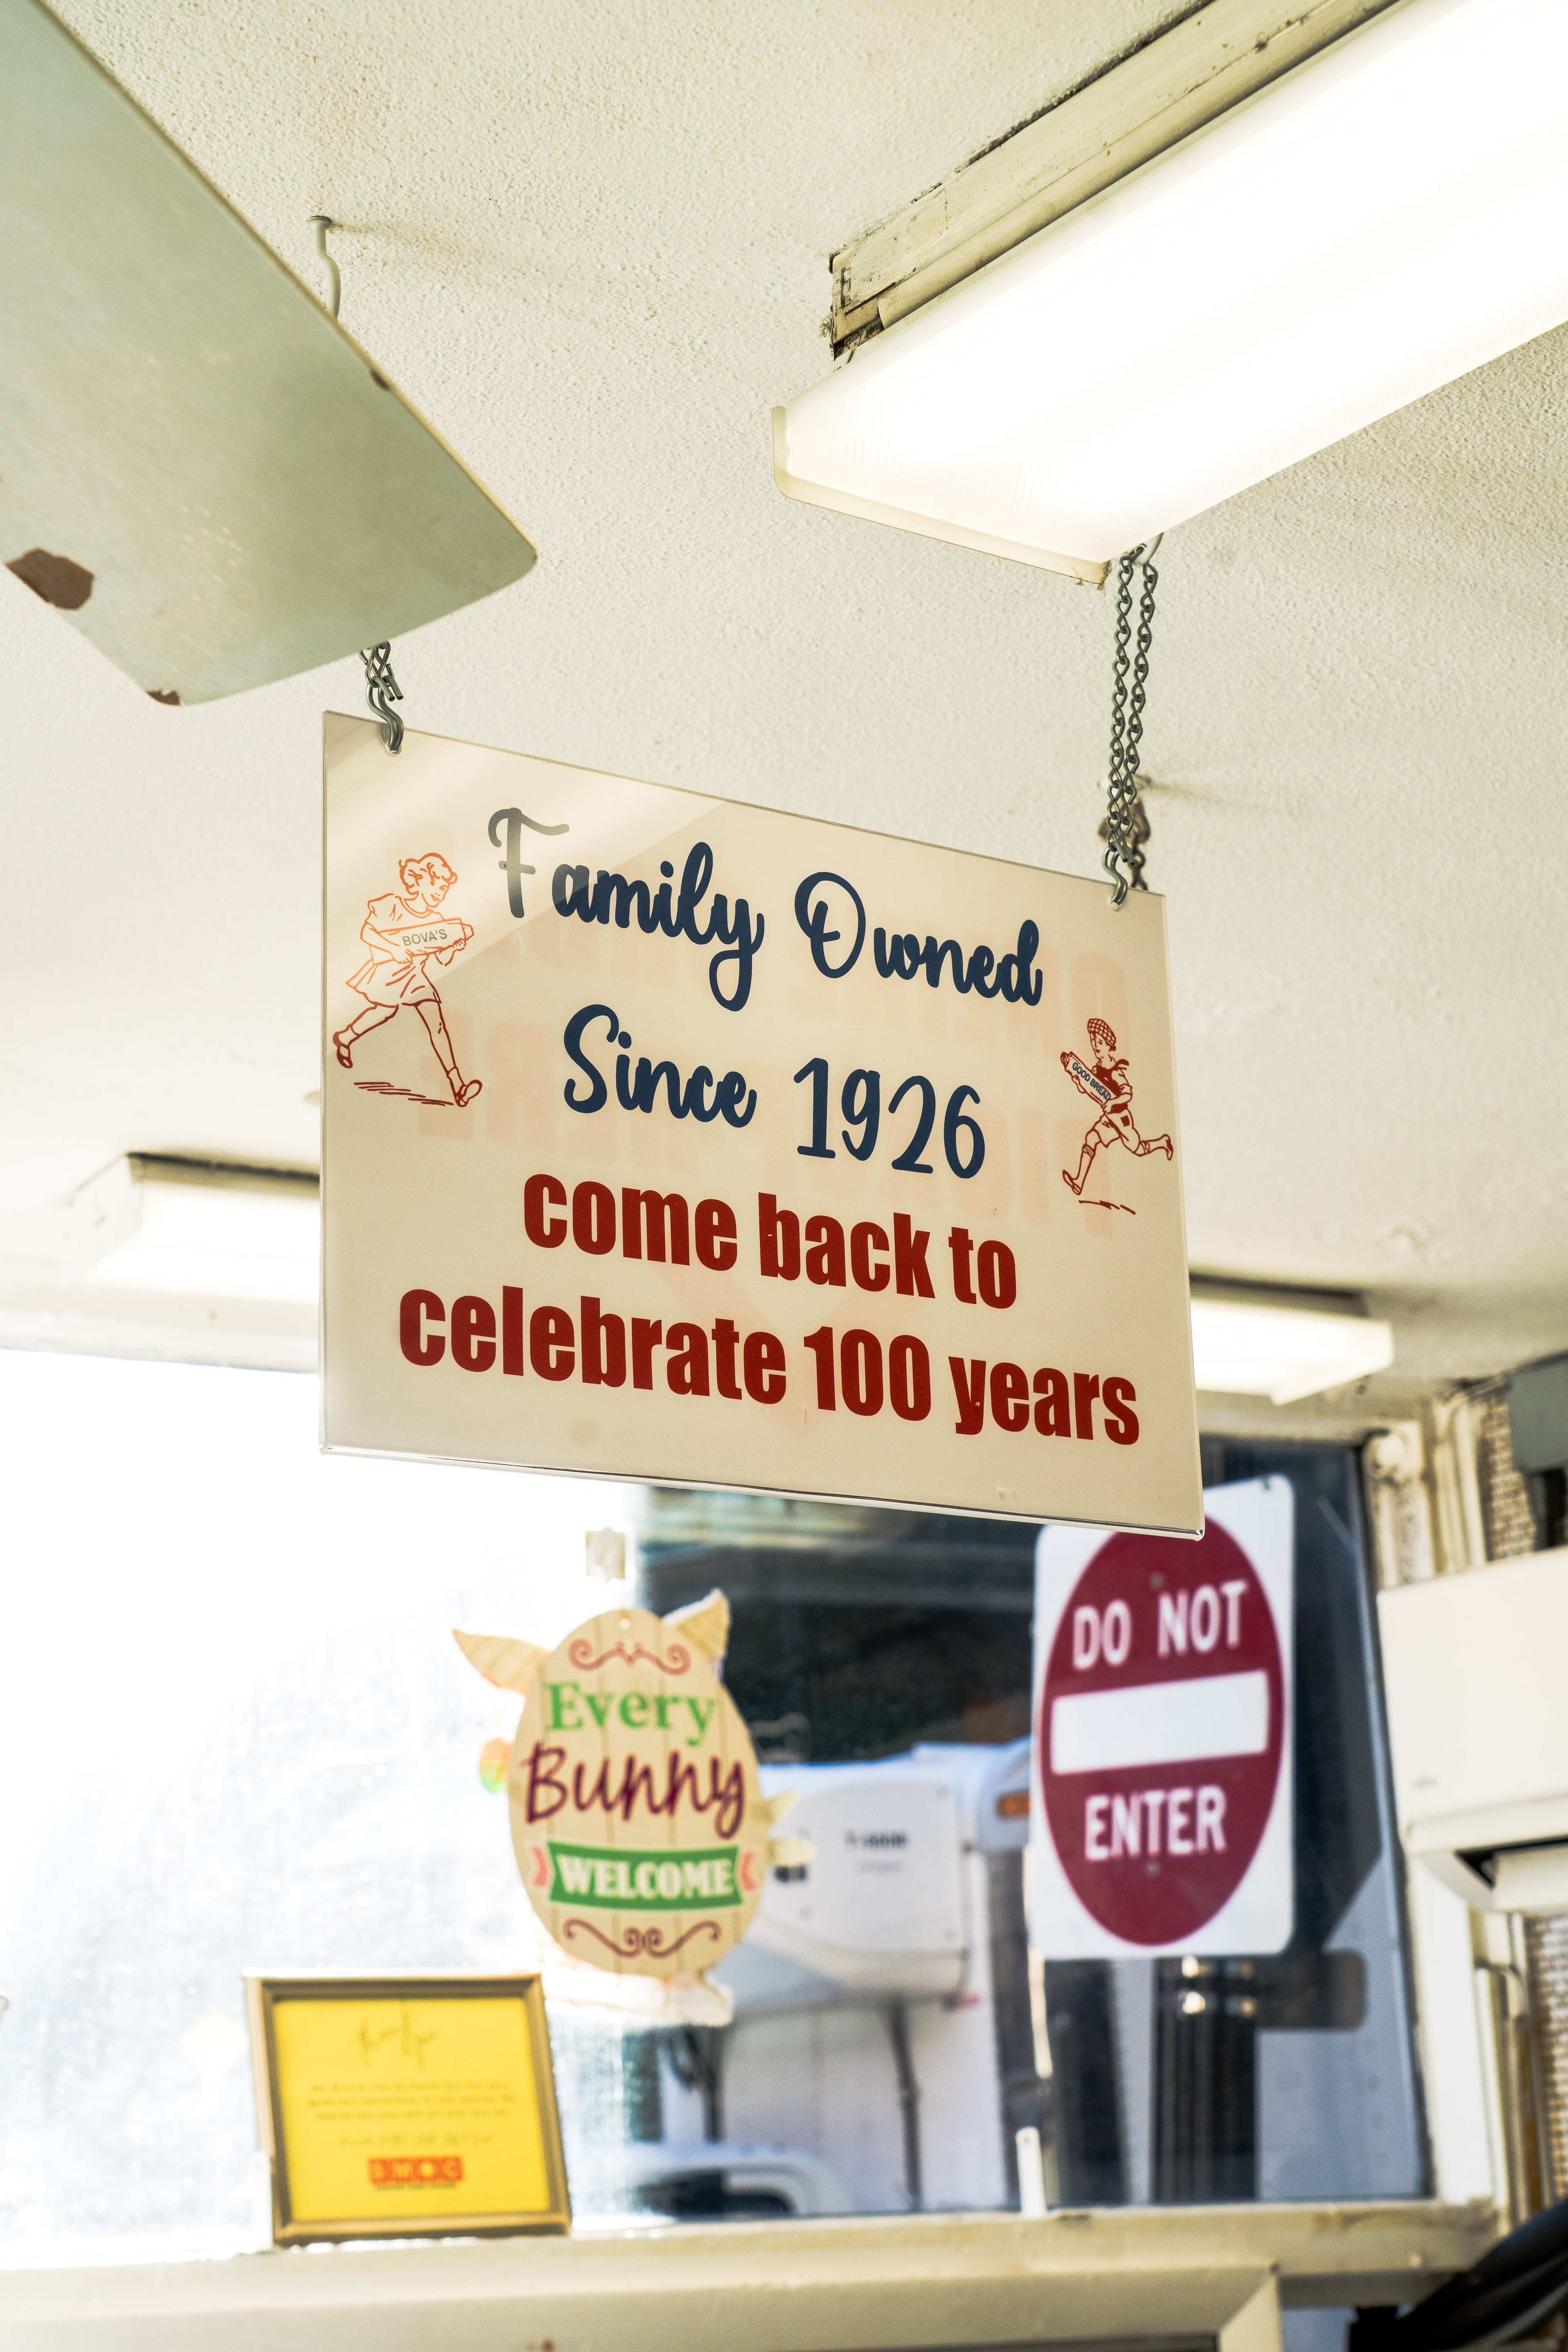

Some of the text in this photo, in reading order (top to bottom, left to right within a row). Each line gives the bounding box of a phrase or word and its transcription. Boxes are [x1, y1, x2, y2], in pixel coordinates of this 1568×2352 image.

[402, 929, 448, 946] BOVA'S
[488, 807, 765, 1012] Family
[794, 871, 1043, 1007] Owned
[564, 1004, 757, 1128] Since
[793, 1058, 985, 1179] 1926
[1072, 1062, 1111, 1100] GOOD BREAD
[523, 1174, 1017, 1309] come back to
[399, 1285, 1140, 1445] celebrate 100 years
[1072, 1579, 1248, 1671] DO NOT
[546, 1681, 717, 1748] Every
[519, 1740, 746, 1840] Bunny
[1084, 1785, 1227, 1862] ENTER
[556, 1853, 735, 1900] WELCOME
